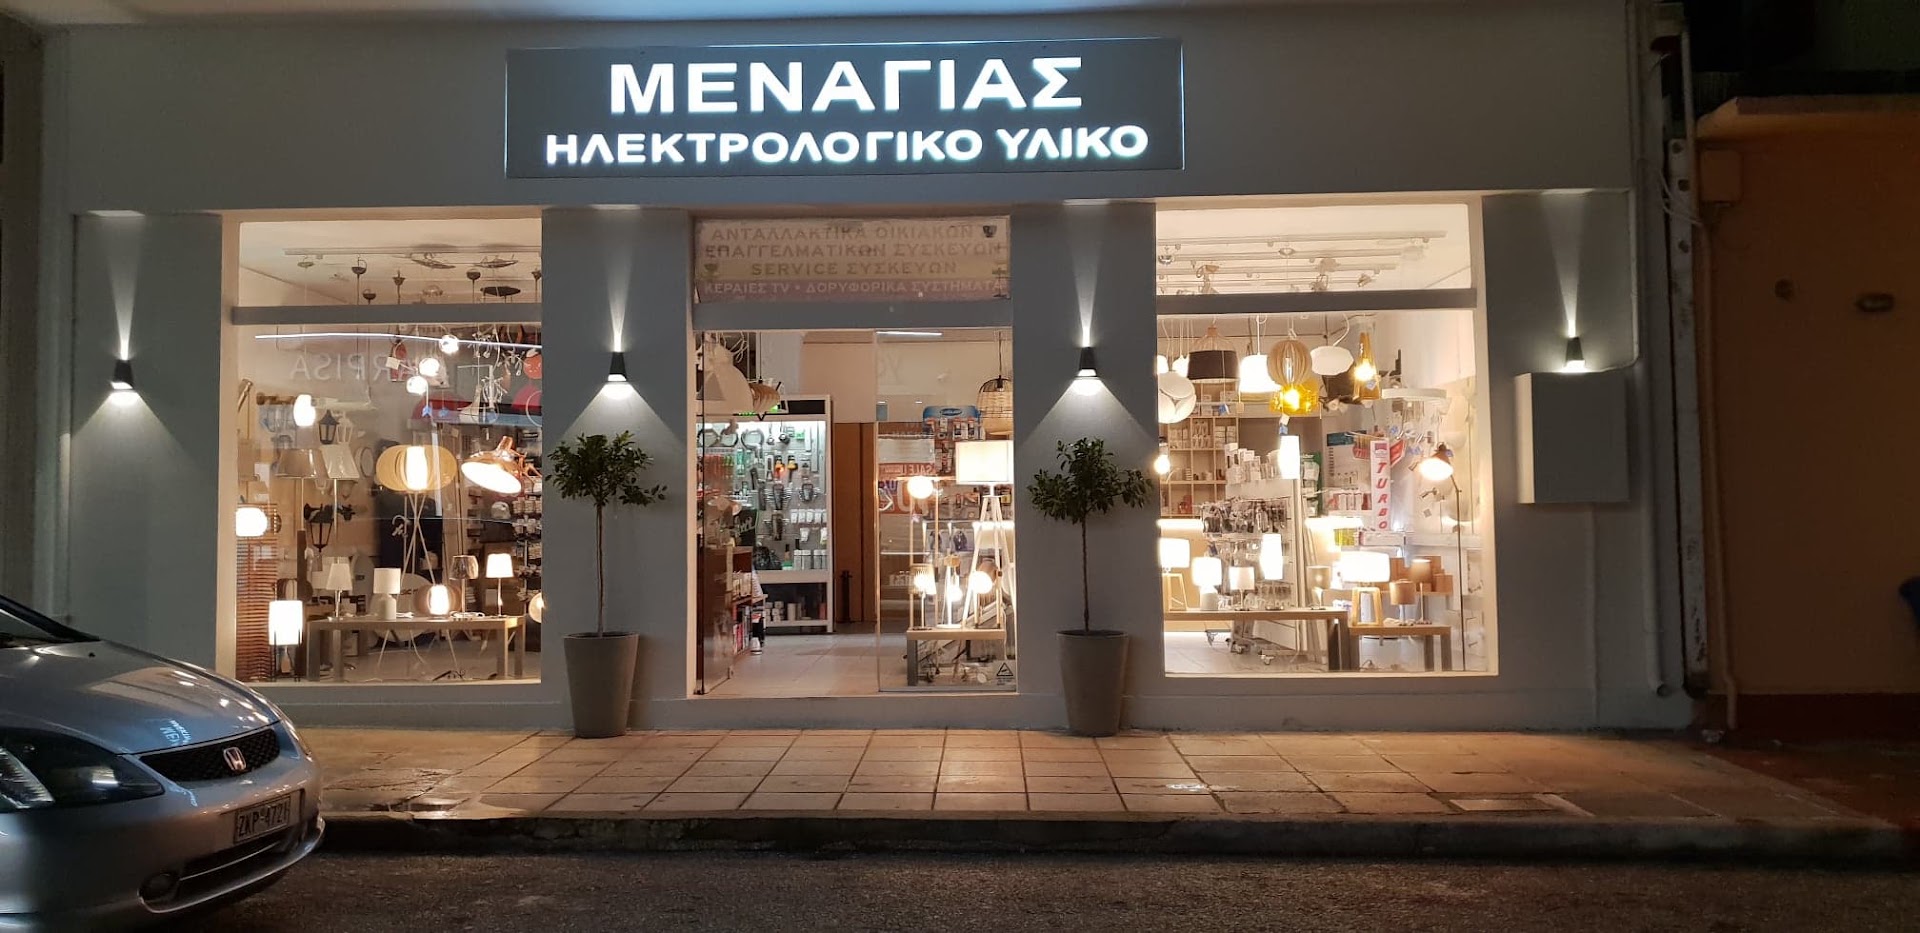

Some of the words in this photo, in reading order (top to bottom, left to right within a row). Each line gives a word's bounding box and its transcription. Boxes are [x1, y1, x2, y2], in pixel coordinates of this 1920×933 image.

[609, 57, 1083, 114] ΜΕΝΑΓΙΑΣ
[545, 129, 982, 165] ΗΛΕΚΤΡΟΛΟΓΙΚΟ
[997, 125, 1149, 160] ΥΛΙΚΟ
[711, 225, 868, 241] ΑΝΤΑΛΛΑΚΤΙΚΑ
[875, 224, 973, 239] ΟΙΚΙΑΚΩΝ
[704, 243, 887, 259] ΕΠΑΓΓΕΛΜΑΤΙΚΩΝ
[893, 242, 1001, 258] ΣΥΣΚΕΥΩΝ
[751, 262, 838, 276] SERVICE
[846, 261, 958, 275] ΣΥΣΚΕΥΩΝ
[704, 282, 767, 295] ΚΕΡΑΙΕΣ
[770, 282, 790, 294] TV
[805, 281, 907, 293] ΔΟΡΥΦΟΡΙΚΑ
[911, 280, 1002, 293] ΣΥΣΤΗΜΑΤΑ
[1375, 462, 1389, 530] TURBO
